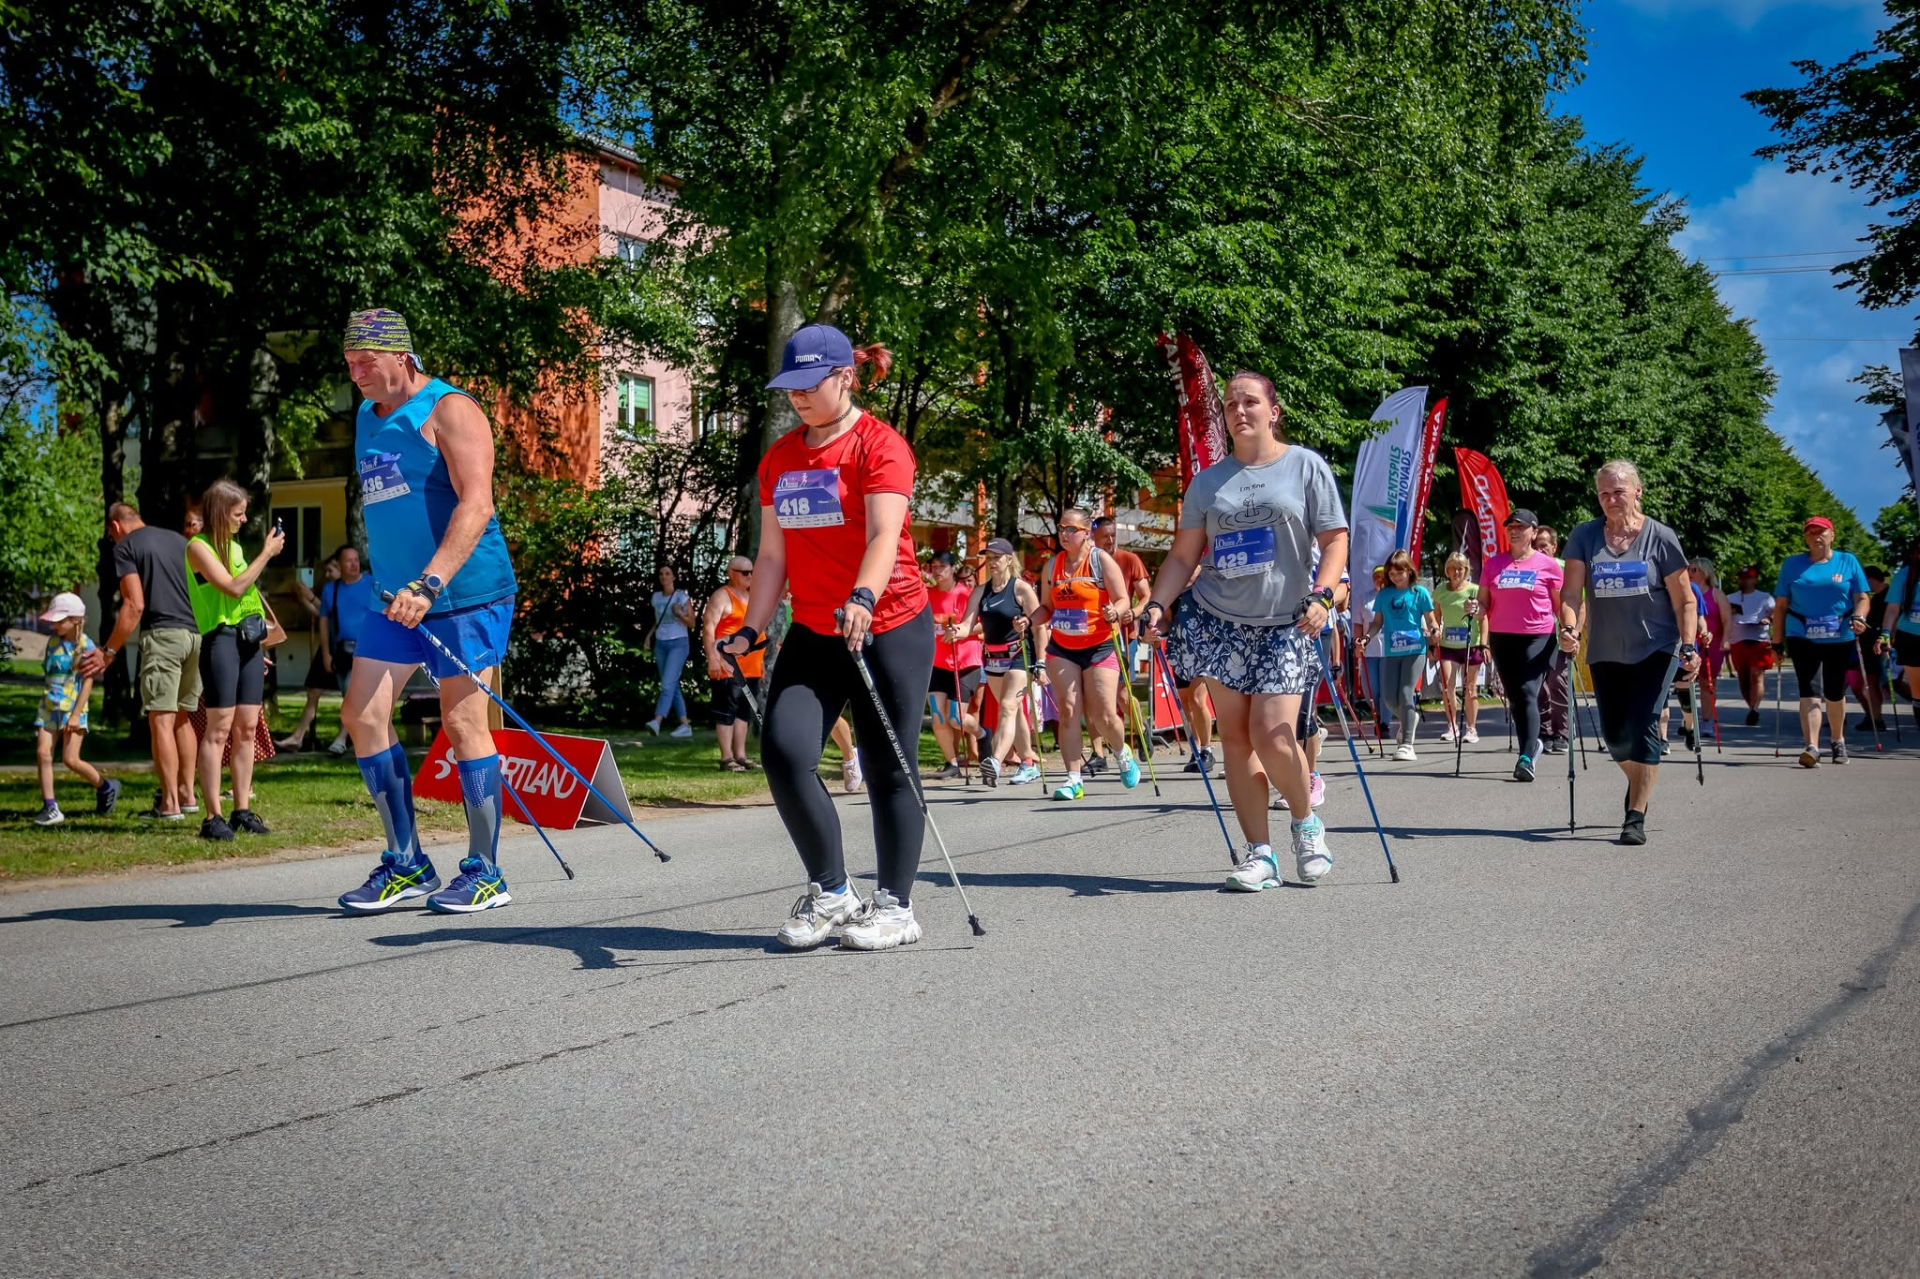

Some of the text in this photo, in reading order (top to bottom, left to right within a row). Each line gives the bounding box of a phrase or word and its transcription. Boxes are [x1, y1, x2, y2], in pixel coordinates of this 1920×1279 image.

[795, 354, 815, 364] PUMA
[362, 475, 384, 494] 436
[1387, 445, 1401, 506] VENTSPILS
[1399, 450, 1411, 502] NOVADS
[779, 497, 810, 516] 418
[1217, 551, 1248, 569] 429
[1595, 577, 1625, 589] 426
[1053, 620, 1071, 629] 410
[1392, 639, 1407, 648] 421
[886, 729, 894, 741] GO
[893, 741, 910, 775] WALKER
